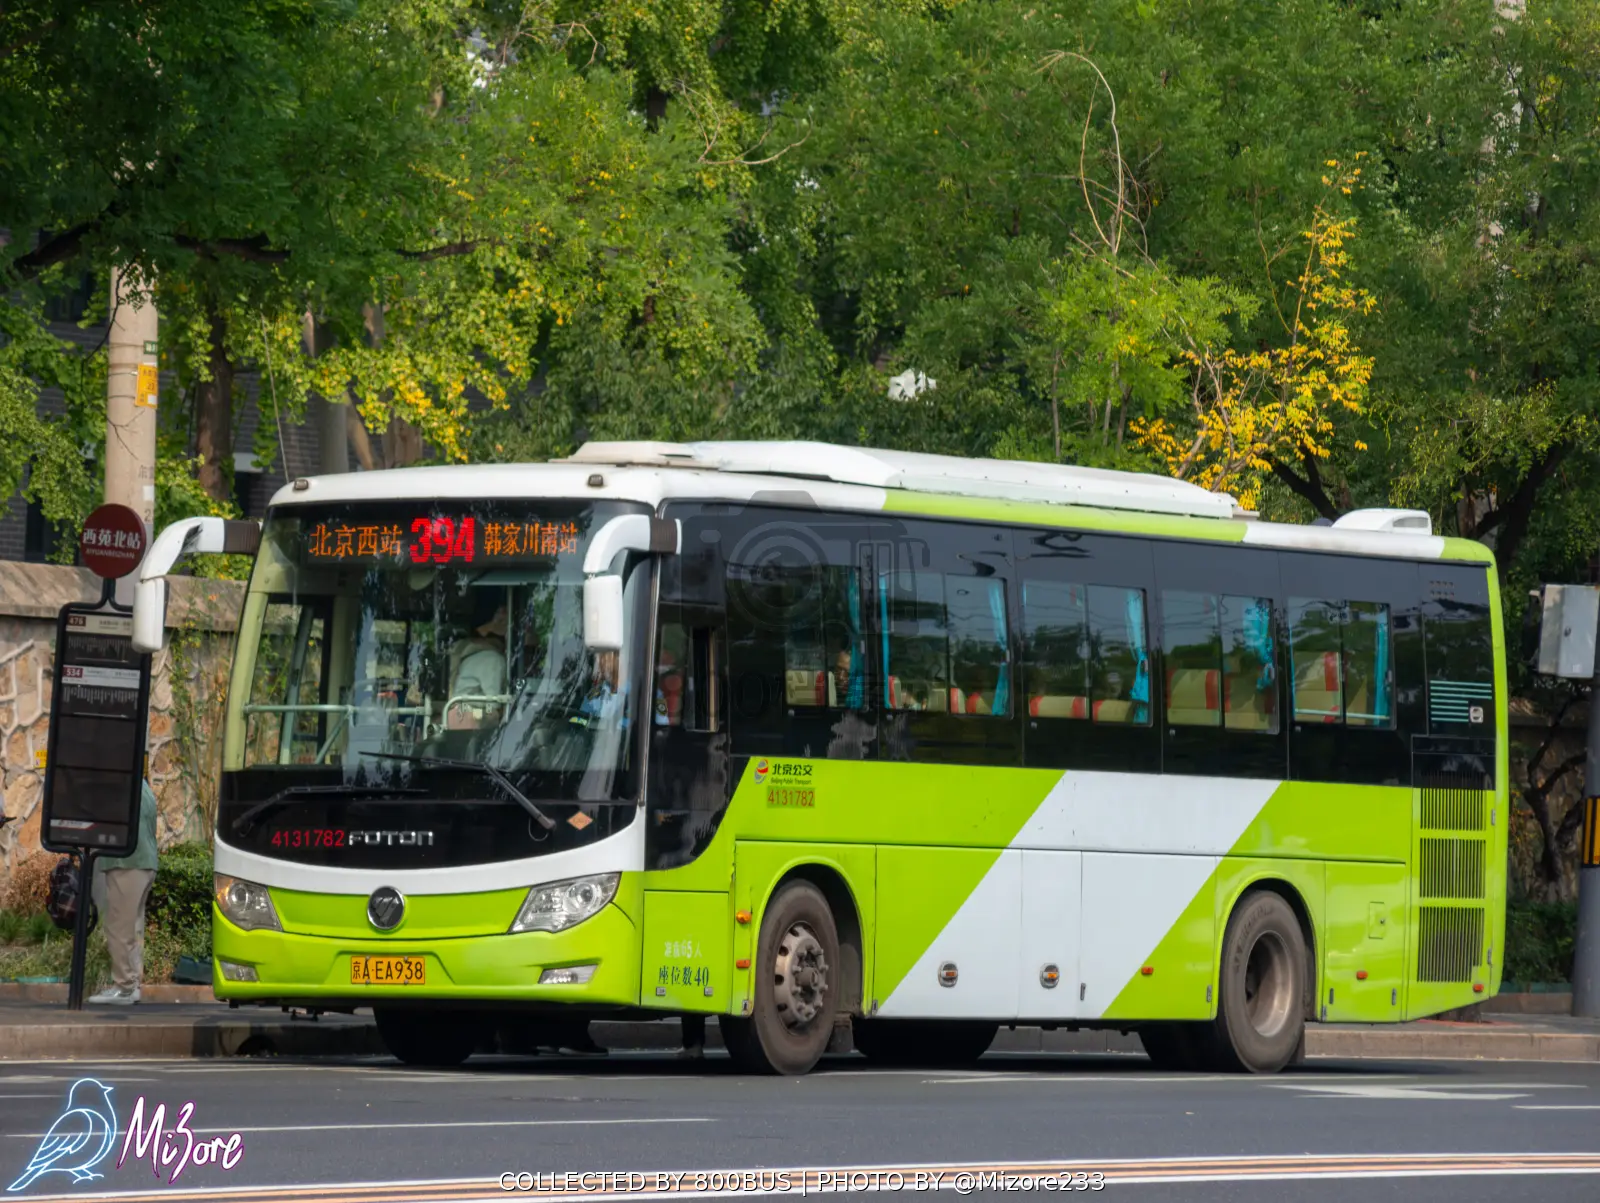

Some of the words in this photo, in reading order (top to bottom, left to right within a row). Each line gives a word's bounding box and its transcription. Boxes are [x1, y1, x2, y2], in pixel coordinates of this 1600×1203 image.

[82, 528, 141, 550] 西苑北站
[309, 524, 402, 557] 北京西站
[410, 517, 475, 563] 394
[484, 522, 578, 555] 韩家川南站
[66, 668, 81, 677] 534
[771, 763, 813, 776] 北京公交
[768, 789, 814, 806] 4131782
[271, 829, 345, 848] 4131782
[348, 830, 434, 846] FOTON
